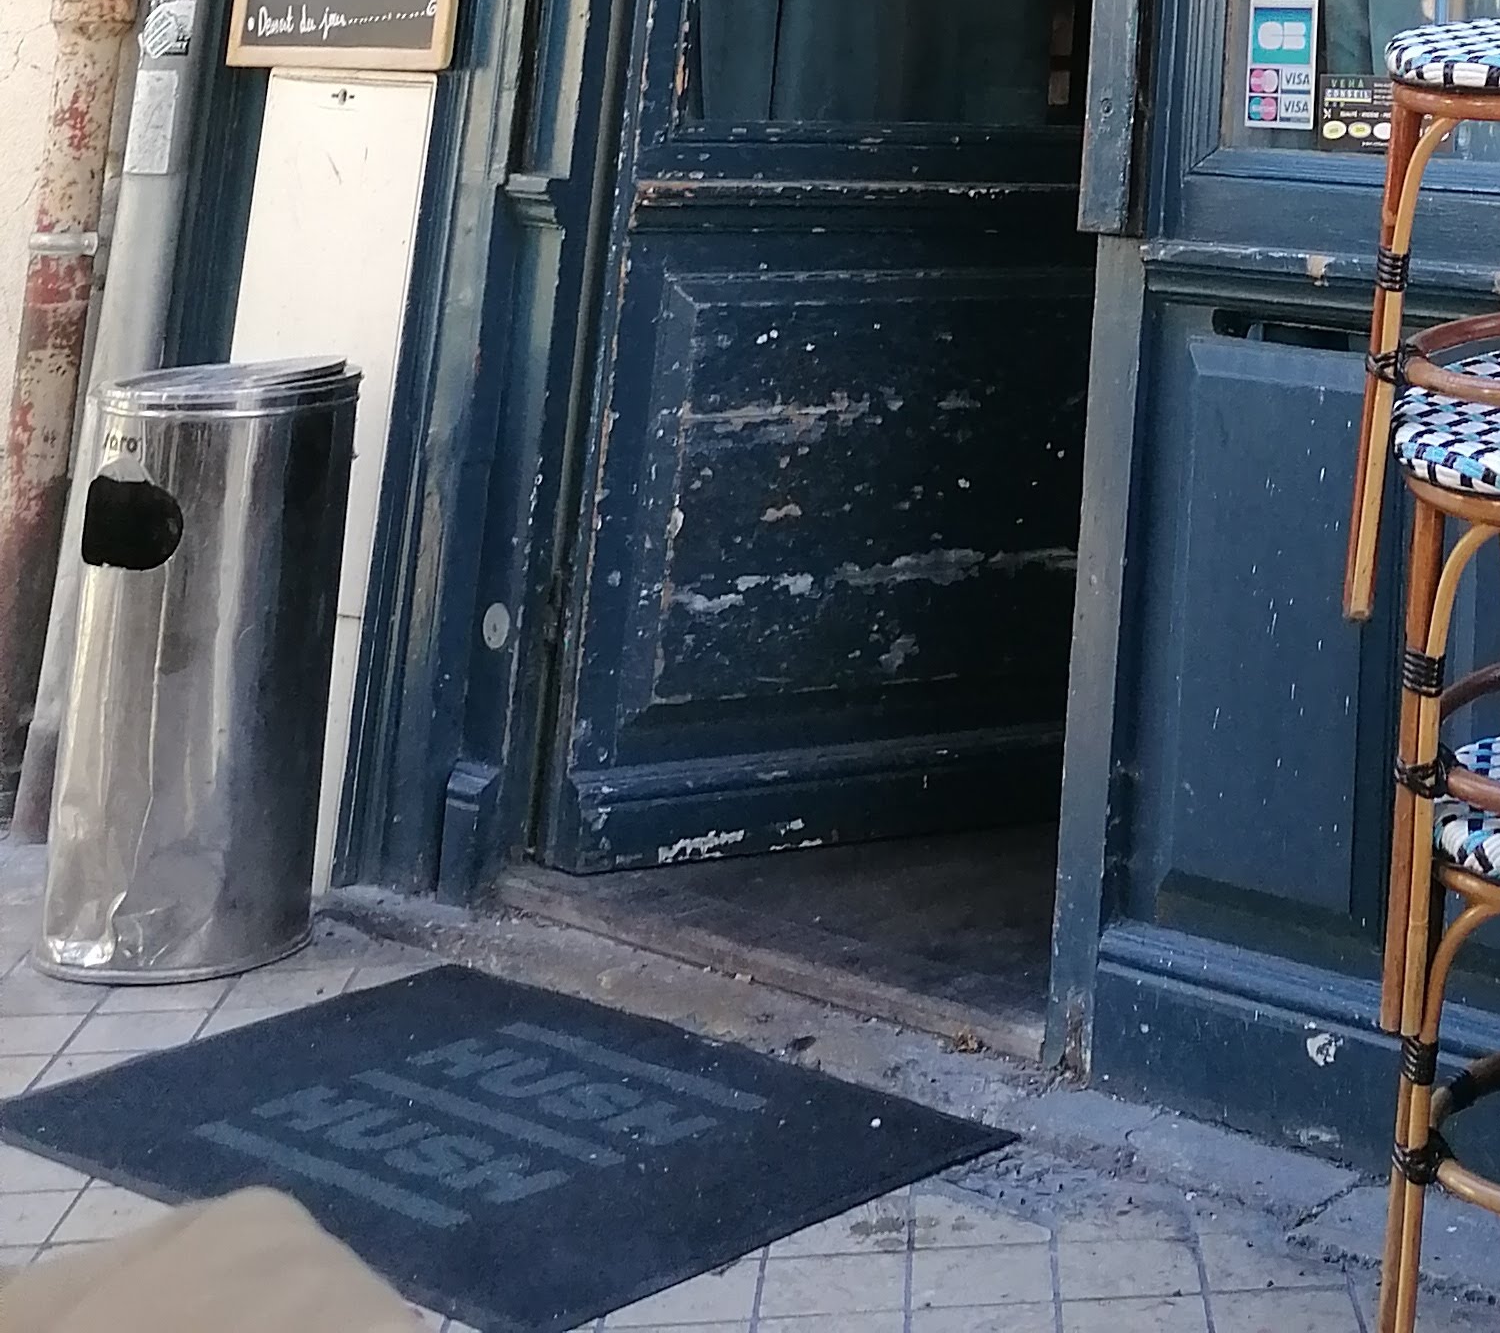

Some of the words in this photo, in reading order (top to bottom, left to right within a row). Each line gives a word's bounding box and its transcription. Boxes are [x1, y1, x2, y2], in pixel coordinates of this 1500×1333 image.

[1283, 100, 1310, 114] VISA
[1284, 71, 1311, 86] VISA
[405, 1037, 718, 1148] HUSH
[251, 1084, 572, 1205] HUSH
